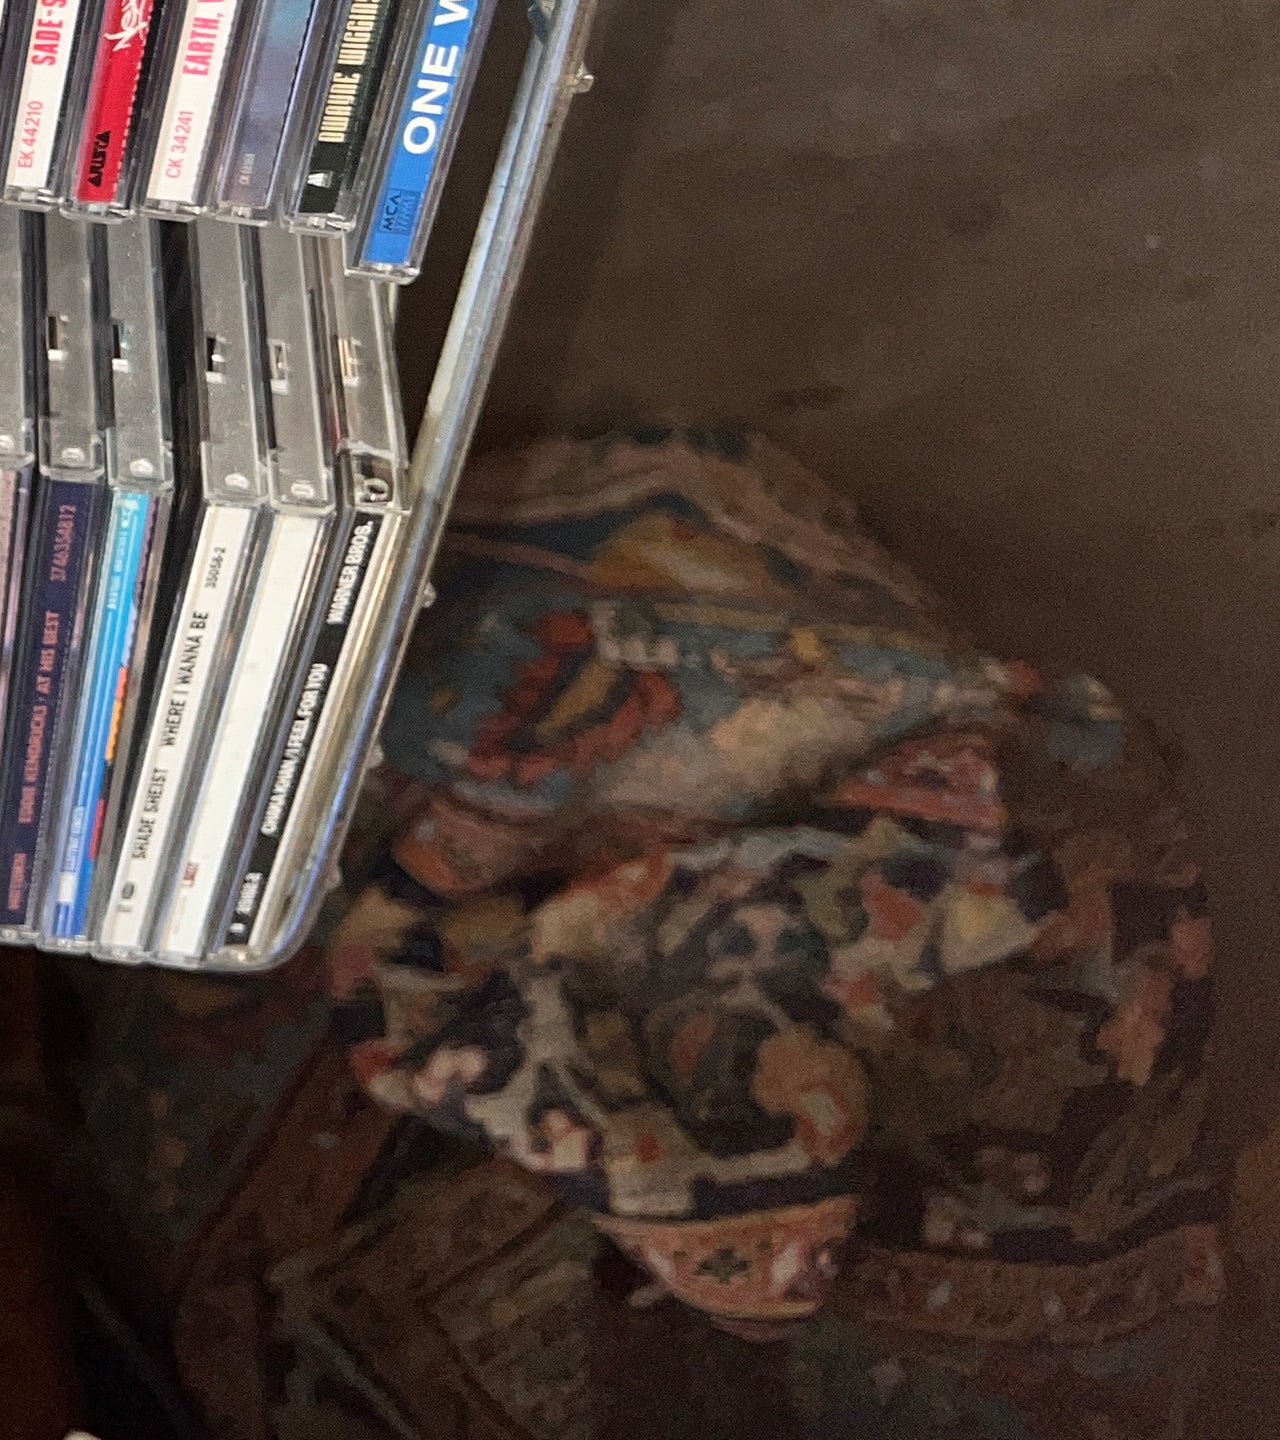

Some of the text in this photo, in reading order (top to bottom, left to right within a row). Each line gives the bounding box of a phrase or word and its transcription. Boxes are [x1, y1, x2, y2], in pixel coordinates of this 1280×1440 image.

[182, 11, 225, 76] EARTH,
[398, 42, 460, 155] ONE
[18, 100, 45, 168] EK 44210
[164, 109, 196, 178] CK 34241
[188, 611, 209, 630] BE
[174, 634, 203, 686] WANNA
[159, 699, 187, 747] WHERE
[142, 766, 169, 813] SHEIST
[131, 817, 156, 859] SHADE
